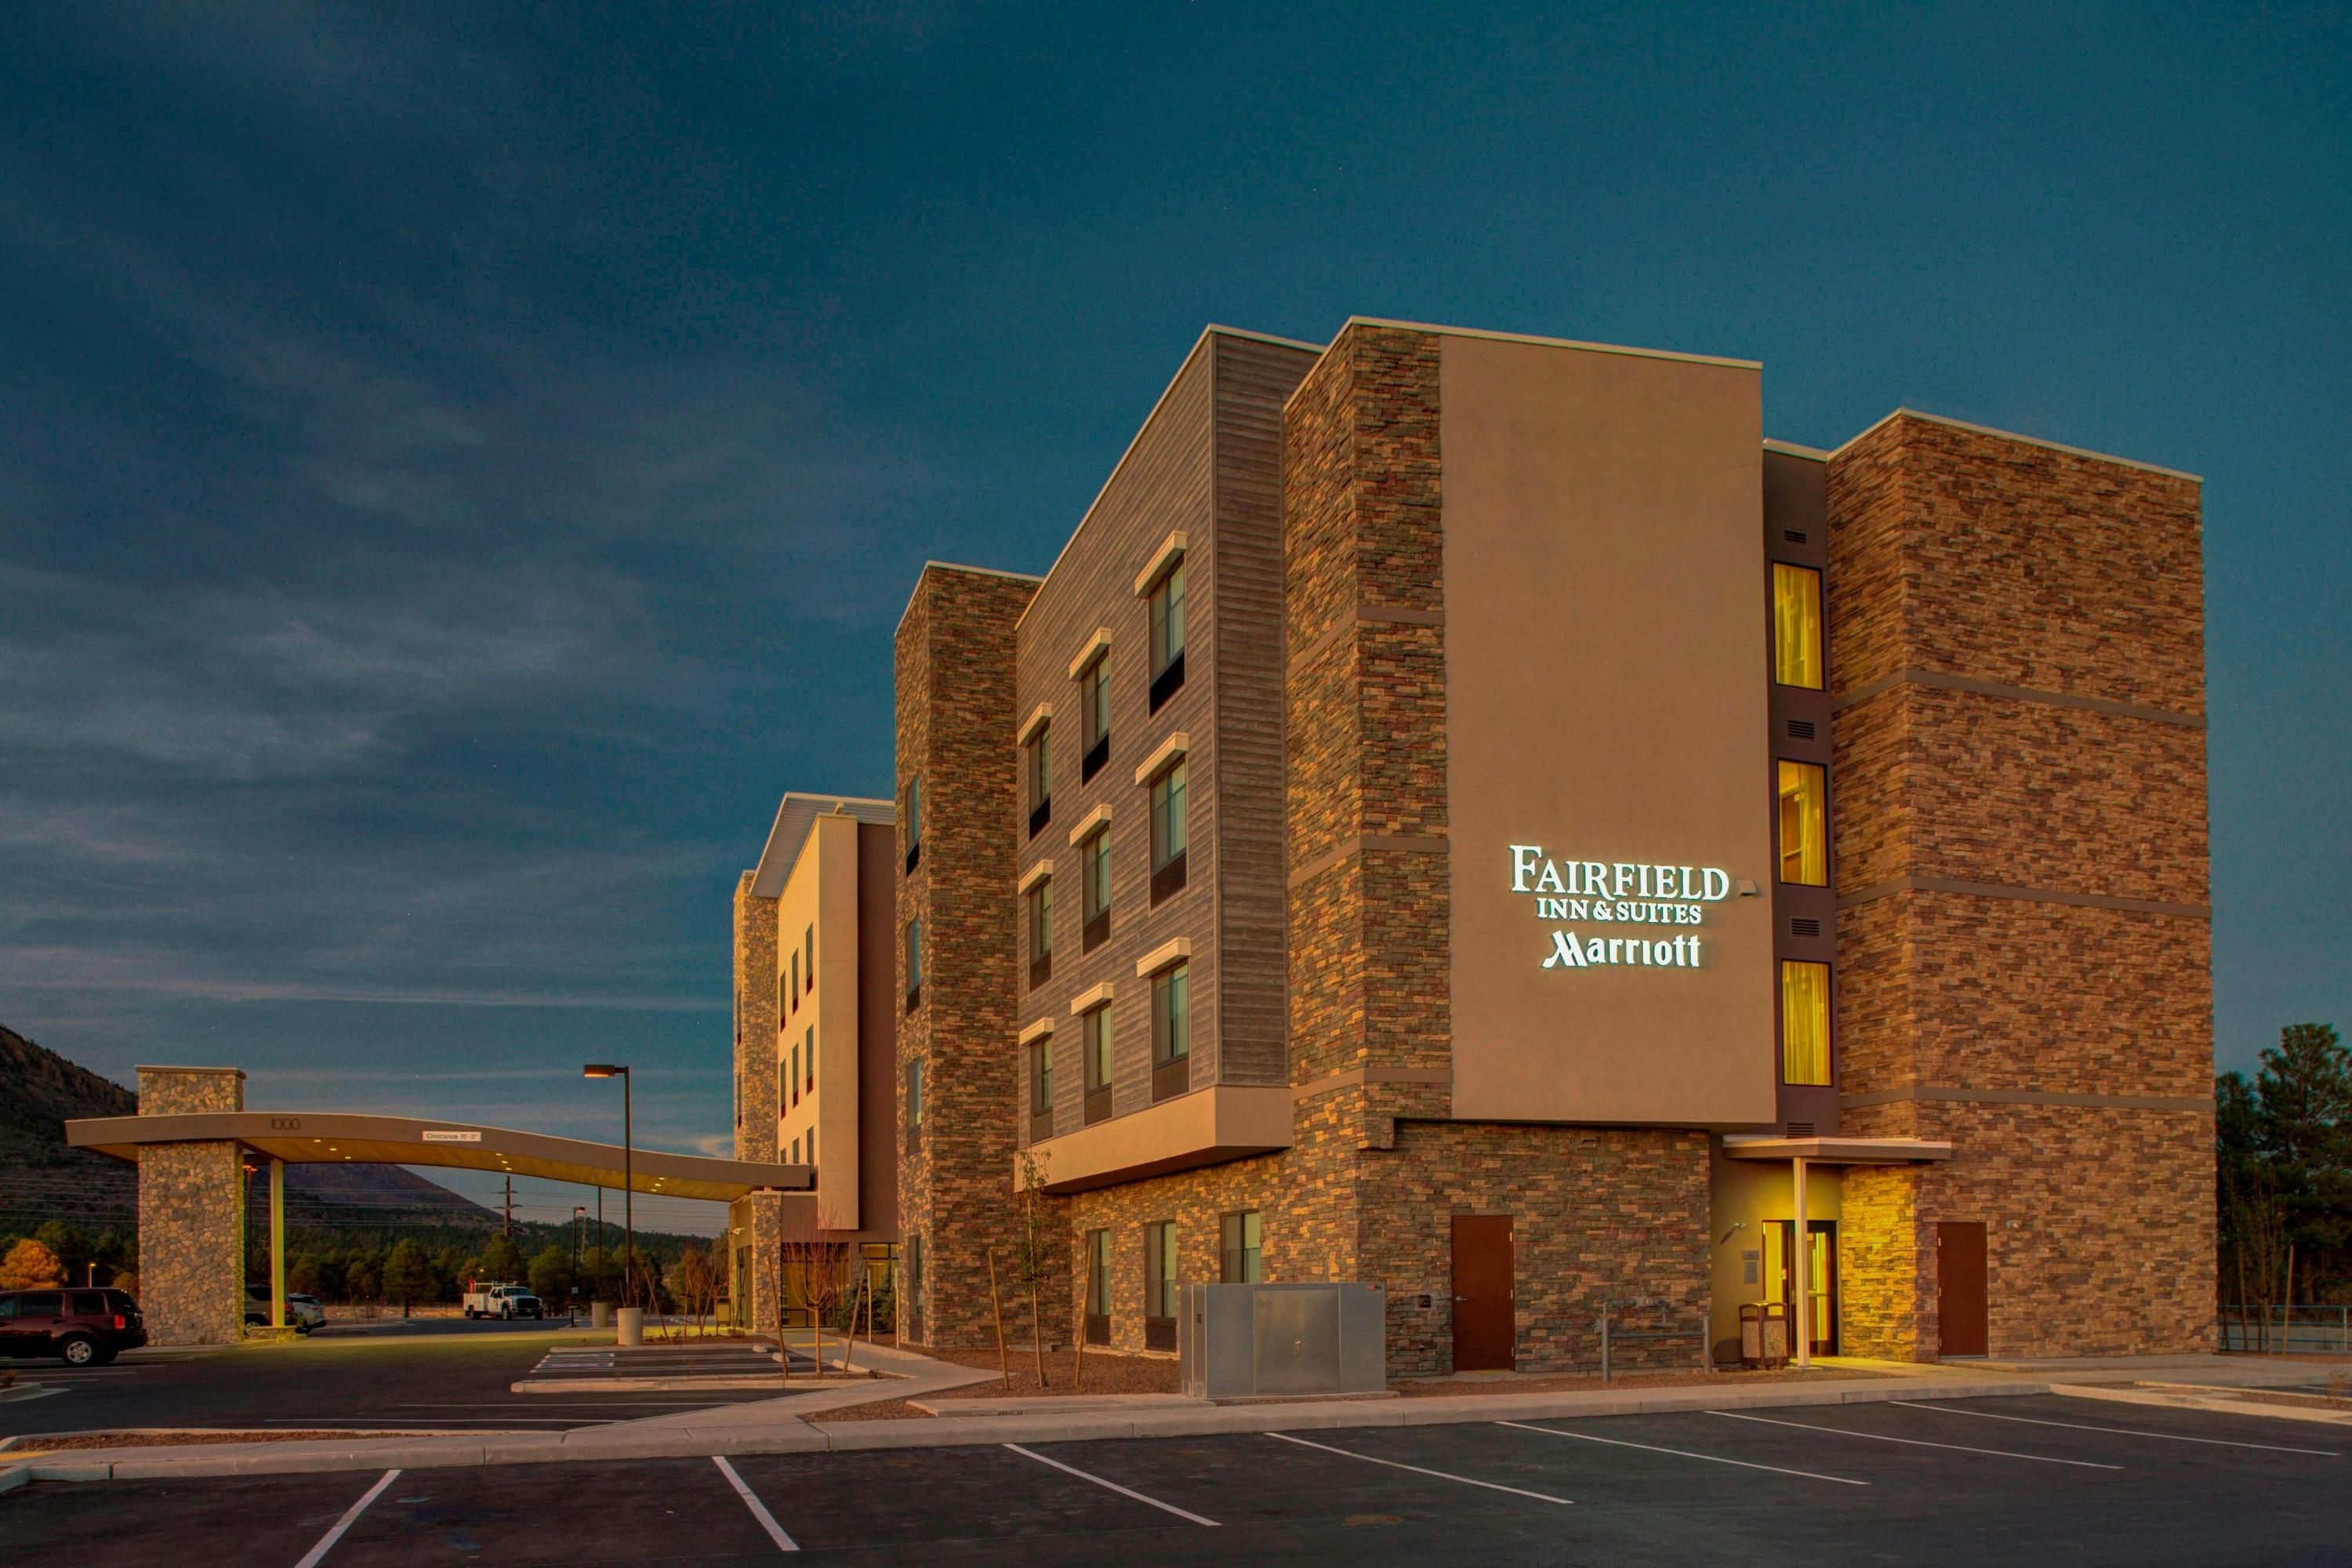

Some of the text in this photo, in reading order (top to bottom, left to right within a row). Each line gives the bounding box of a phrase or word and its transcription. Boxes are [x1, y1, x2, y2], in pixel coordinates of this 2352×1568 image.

[1509, 844, 1730, 902] FAIRFIELD
[1536, 897, 1702, 925] INN & SUITES
[1541, 929, 1701, 969] Marriott
[270, 1117, 301, 1131] 1000
